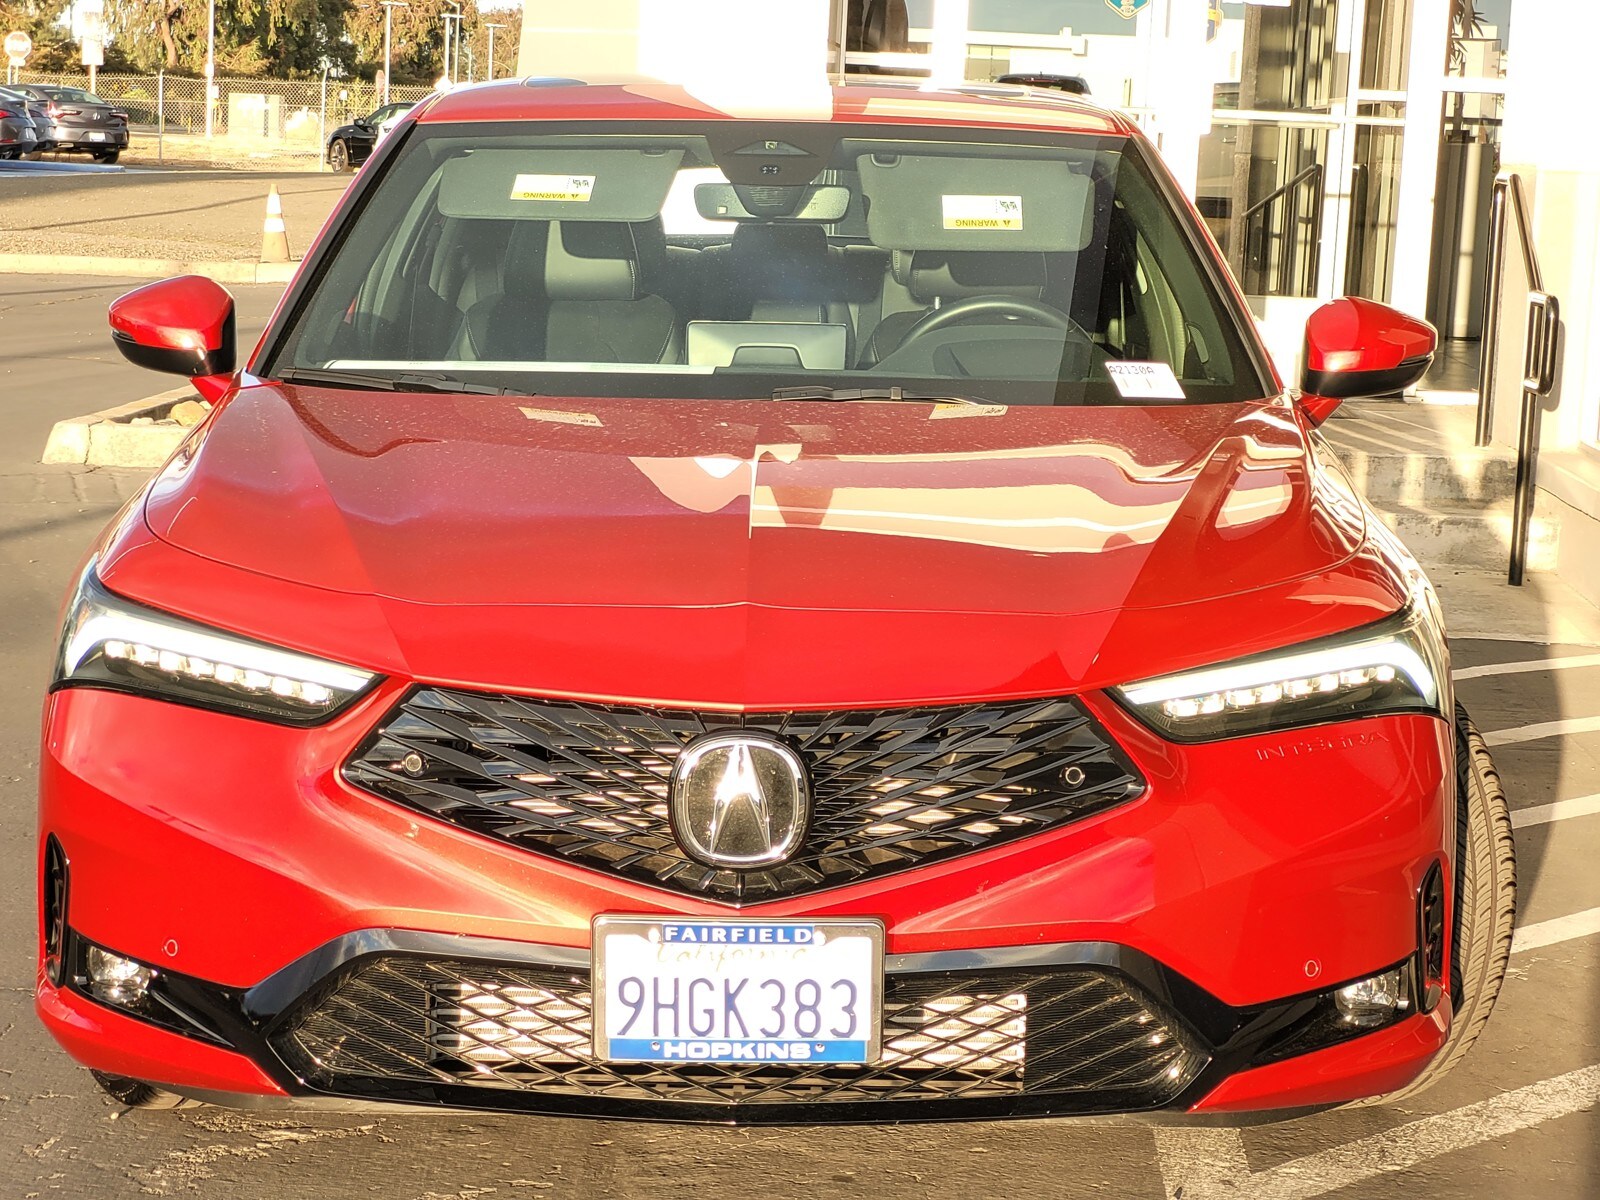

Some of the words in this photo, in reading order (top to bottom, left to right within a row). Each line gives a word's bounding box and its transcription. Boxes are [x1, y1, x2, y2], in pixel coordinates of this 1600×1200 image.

[955, 219, 999, 227] WARNING
[665, 926, 813, 943] FAIRFIELD
[616, 976, 858, 1039] 9HGK383
[663, 1042, 811, 1060] HOPKINS
